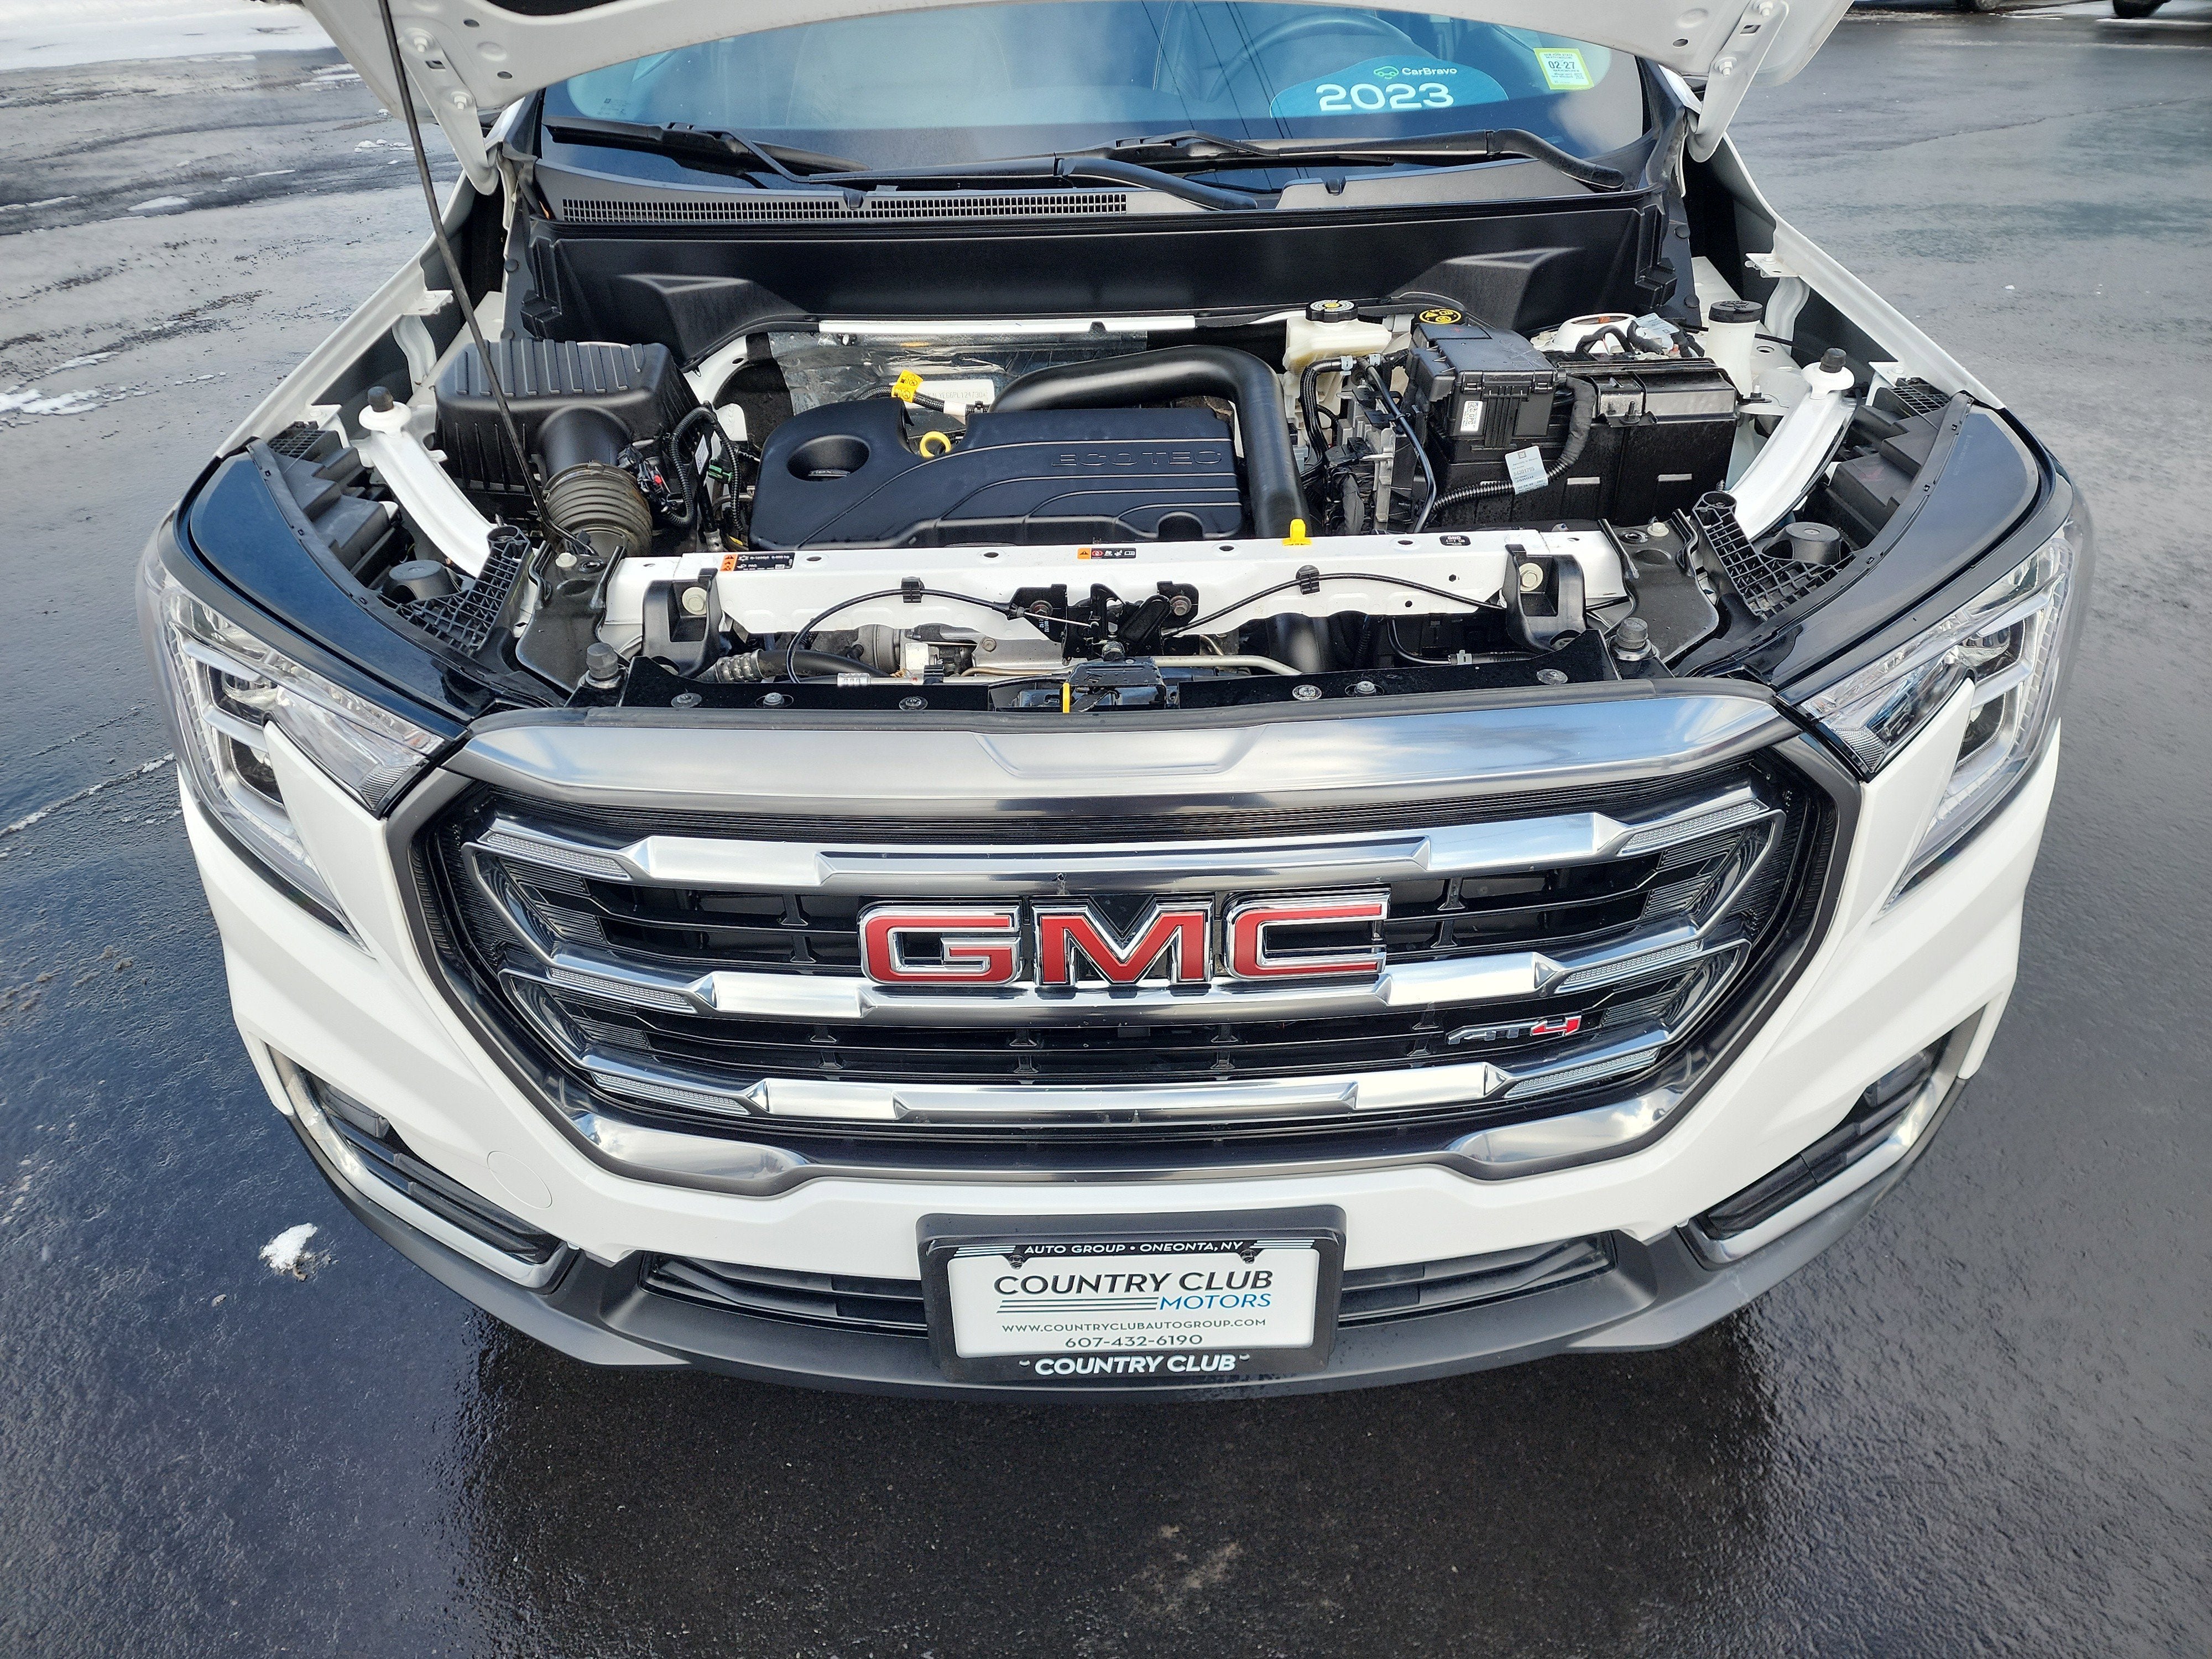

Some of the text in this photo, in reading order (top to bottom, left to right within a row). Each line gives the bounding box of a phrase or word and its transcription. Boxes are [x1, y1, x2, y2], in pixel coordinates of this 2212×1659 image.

[1401, 67, 1457, 76] CarBravo
[1548, 61, 1575, 69] 02-27
[1316, 83, 1454, 111] 2023
[1052, 451, 1222, 466] ECOTEC
[860, 887, 1391, 985] GMC
[1447, 1014, 1582, 1045] AT4
[1024, 1245, 1067, 1254] AUTO
[1071, 1244, 1125, 1254] GROUP
[994, 1270, 1274, 1295] COUNTRY CLUB
[1160, 1293, 1272, 1311] MOTORS
[1002, 1319, 1266, 1333] WWW.COUNTRYCLUBAUTOGROUP.COM
[1065, 1334, 1203, 1348] 607-432-6190
[1034, 1354, 1237, 1376] COUNTRY CLUB
